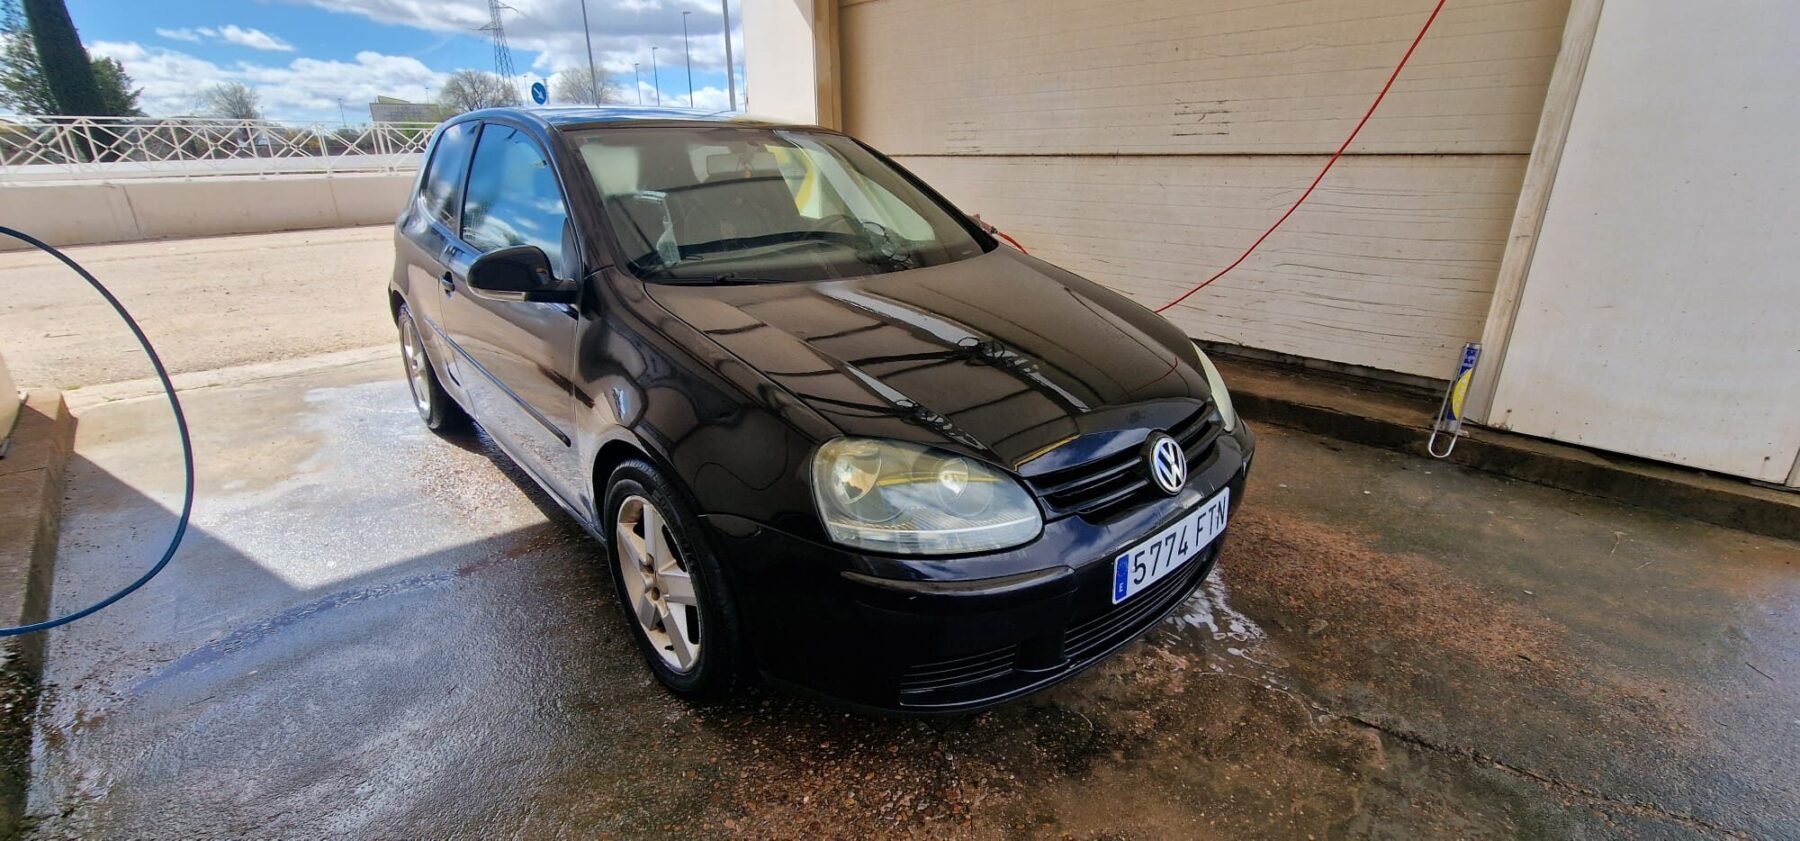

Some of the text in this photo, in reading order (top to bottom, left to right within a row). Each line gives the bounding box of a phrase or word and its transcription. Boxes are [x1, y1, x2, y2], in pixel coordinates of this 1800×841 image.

[1153, 437, 1187, 493] VW
[1119, 496, 1226, 592] E 5774 FTN
